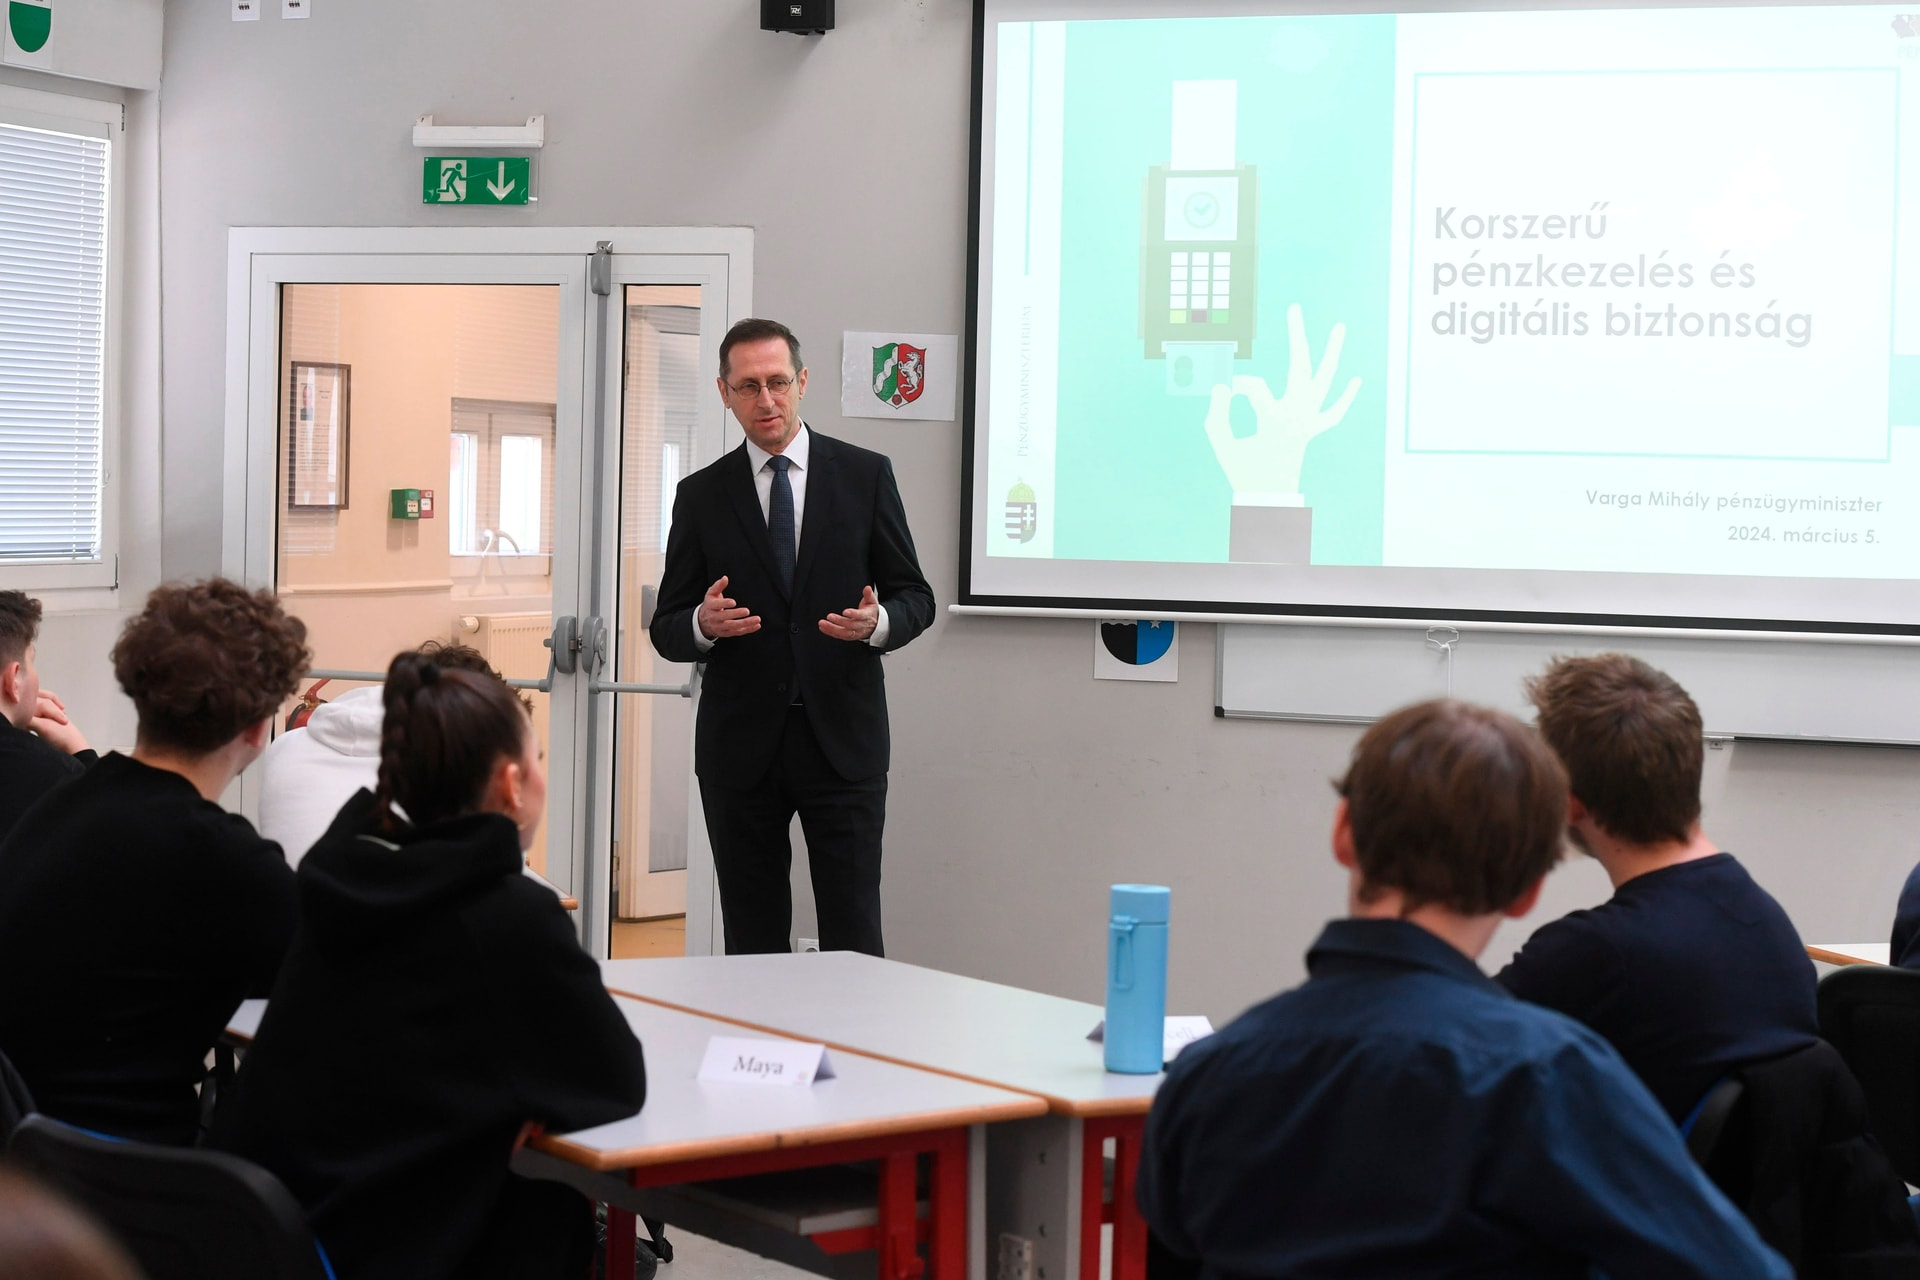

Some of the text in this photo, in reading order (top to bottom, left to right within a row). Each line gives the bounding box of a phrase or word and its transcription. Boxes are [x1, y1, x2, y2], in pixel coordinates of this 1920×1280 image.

[1435, 201, 1610, 240] Korszerű
[1432, 249, 1756, 296] pénzkezelés és
[1431, 298, 1813, 348] digitális biztonság
[1586, 489, 1883, 514] Varga Mihály pénzügyminiszter
[1727, 525, 1880, 544] 2024. március 5.
[733, 1055, 784, 1078] Maya
